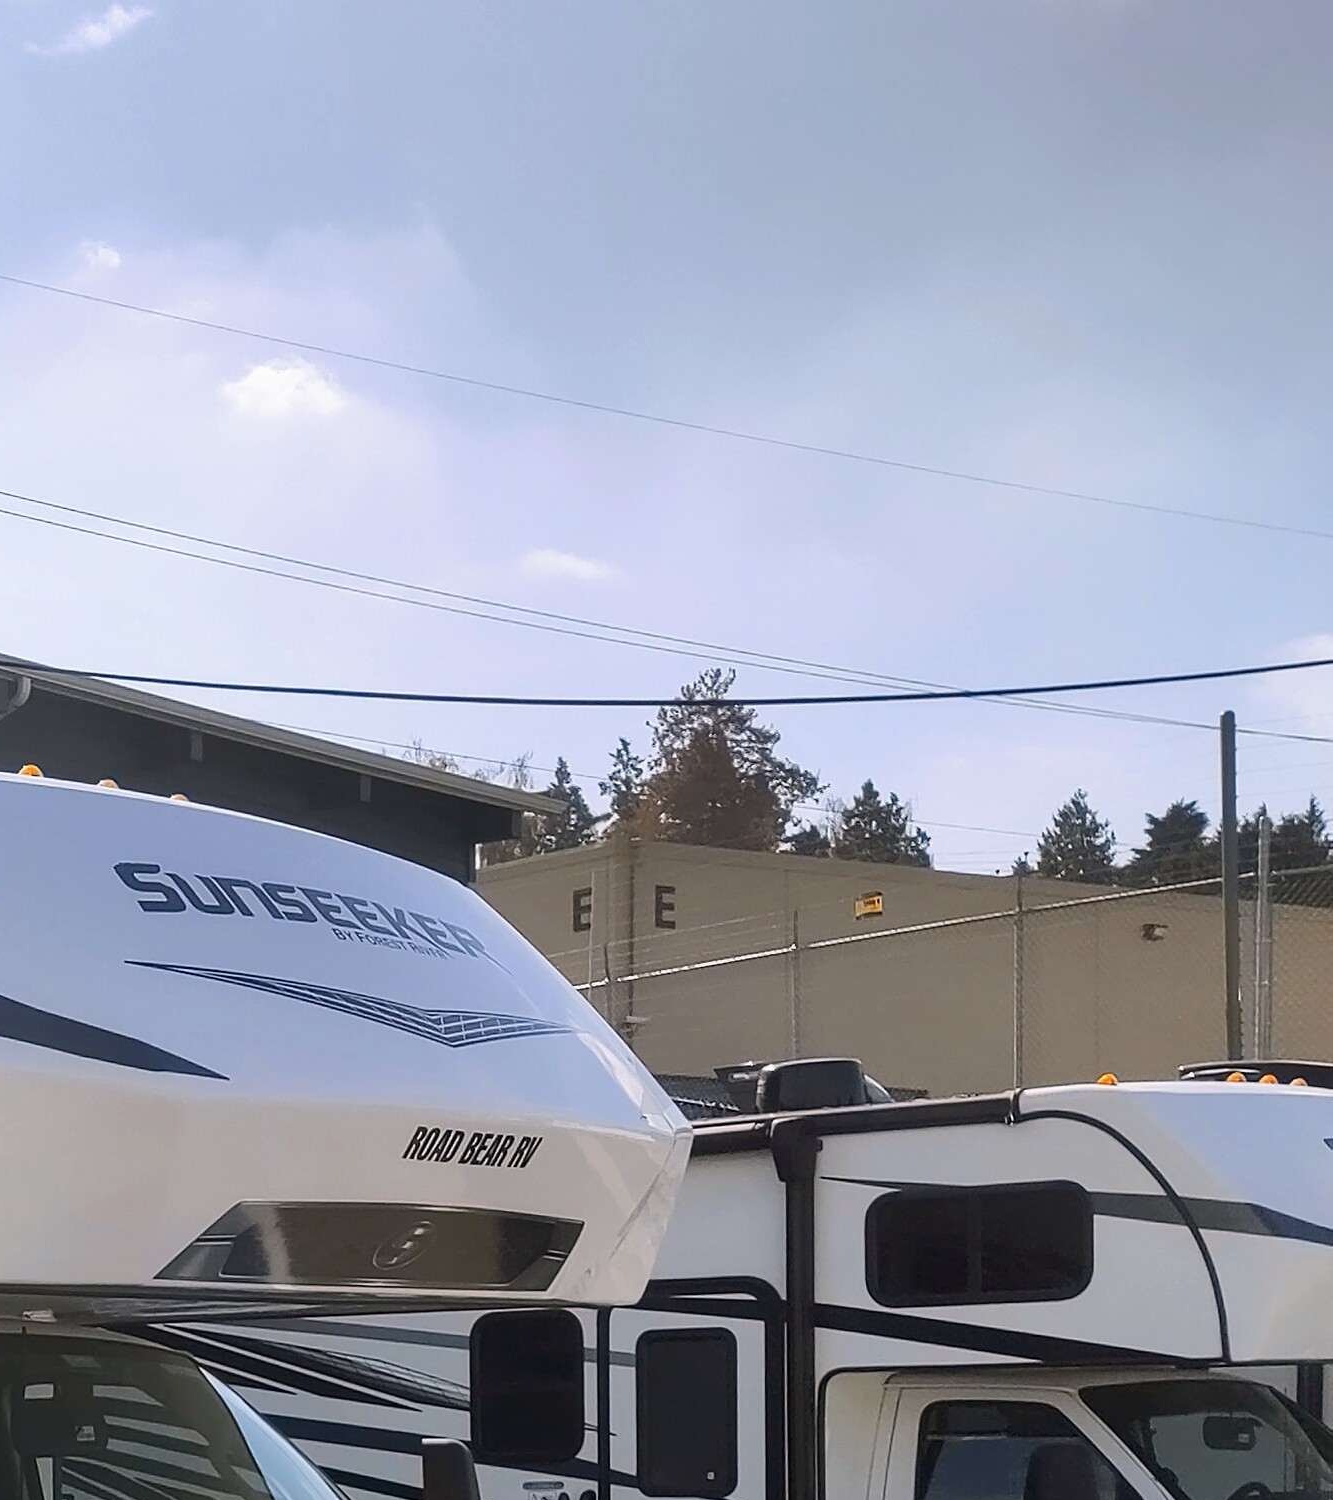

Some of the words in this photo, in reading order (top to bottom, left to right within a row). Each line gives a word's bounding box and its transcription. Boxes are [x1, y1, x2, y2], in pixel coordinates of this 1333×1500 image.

[572, 886, 592, 932] E
[654, 884, 676, 930] E
[402, 1126, 465, 1163] ROAD
[457, 1132, 515, 1167] BEAR
[507, 1136, 543, 1168] RV
